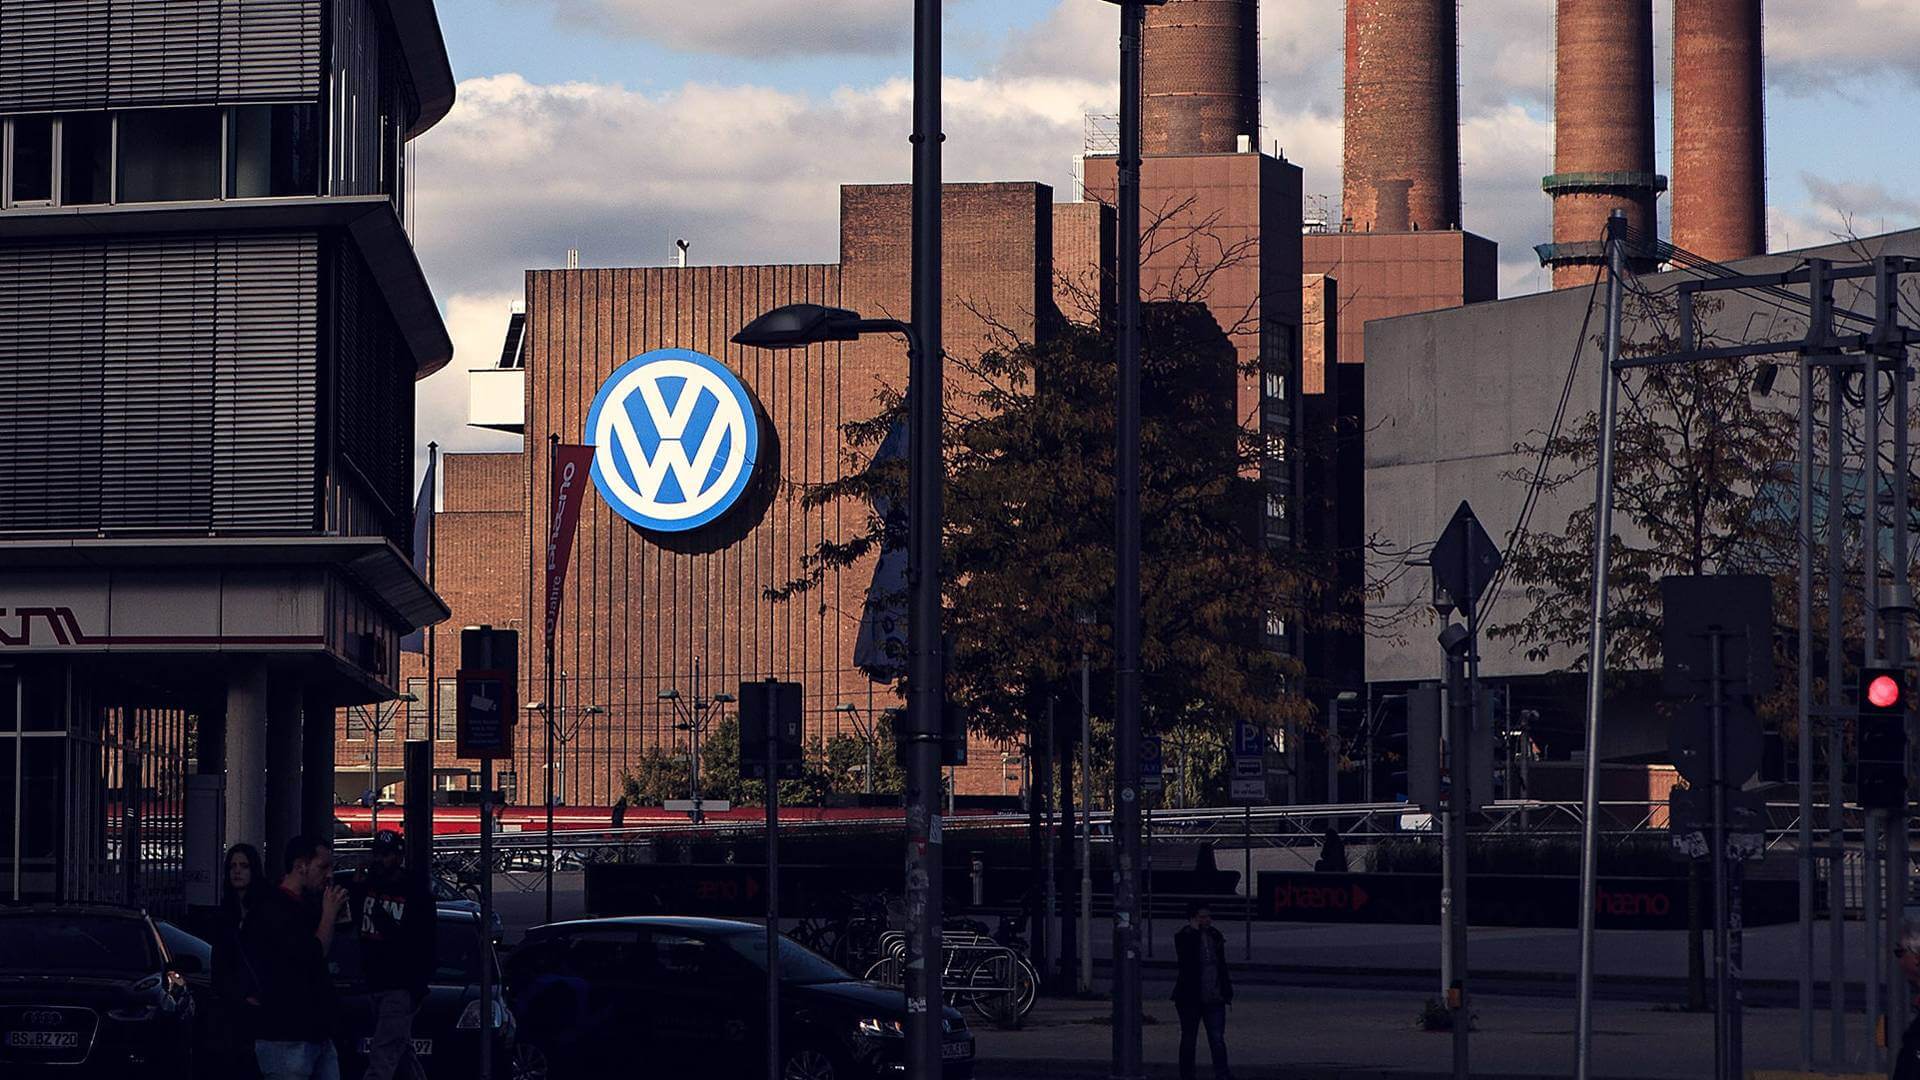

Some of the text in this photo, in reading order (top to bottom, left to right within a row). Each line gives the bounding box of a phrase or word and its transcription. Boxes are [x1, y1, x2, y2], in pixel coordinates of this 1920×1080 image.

[594, 358, 748, 522] VW
[1592, 882, 1671, 917] hæno
[11, 1032, 28, 1046] BS
